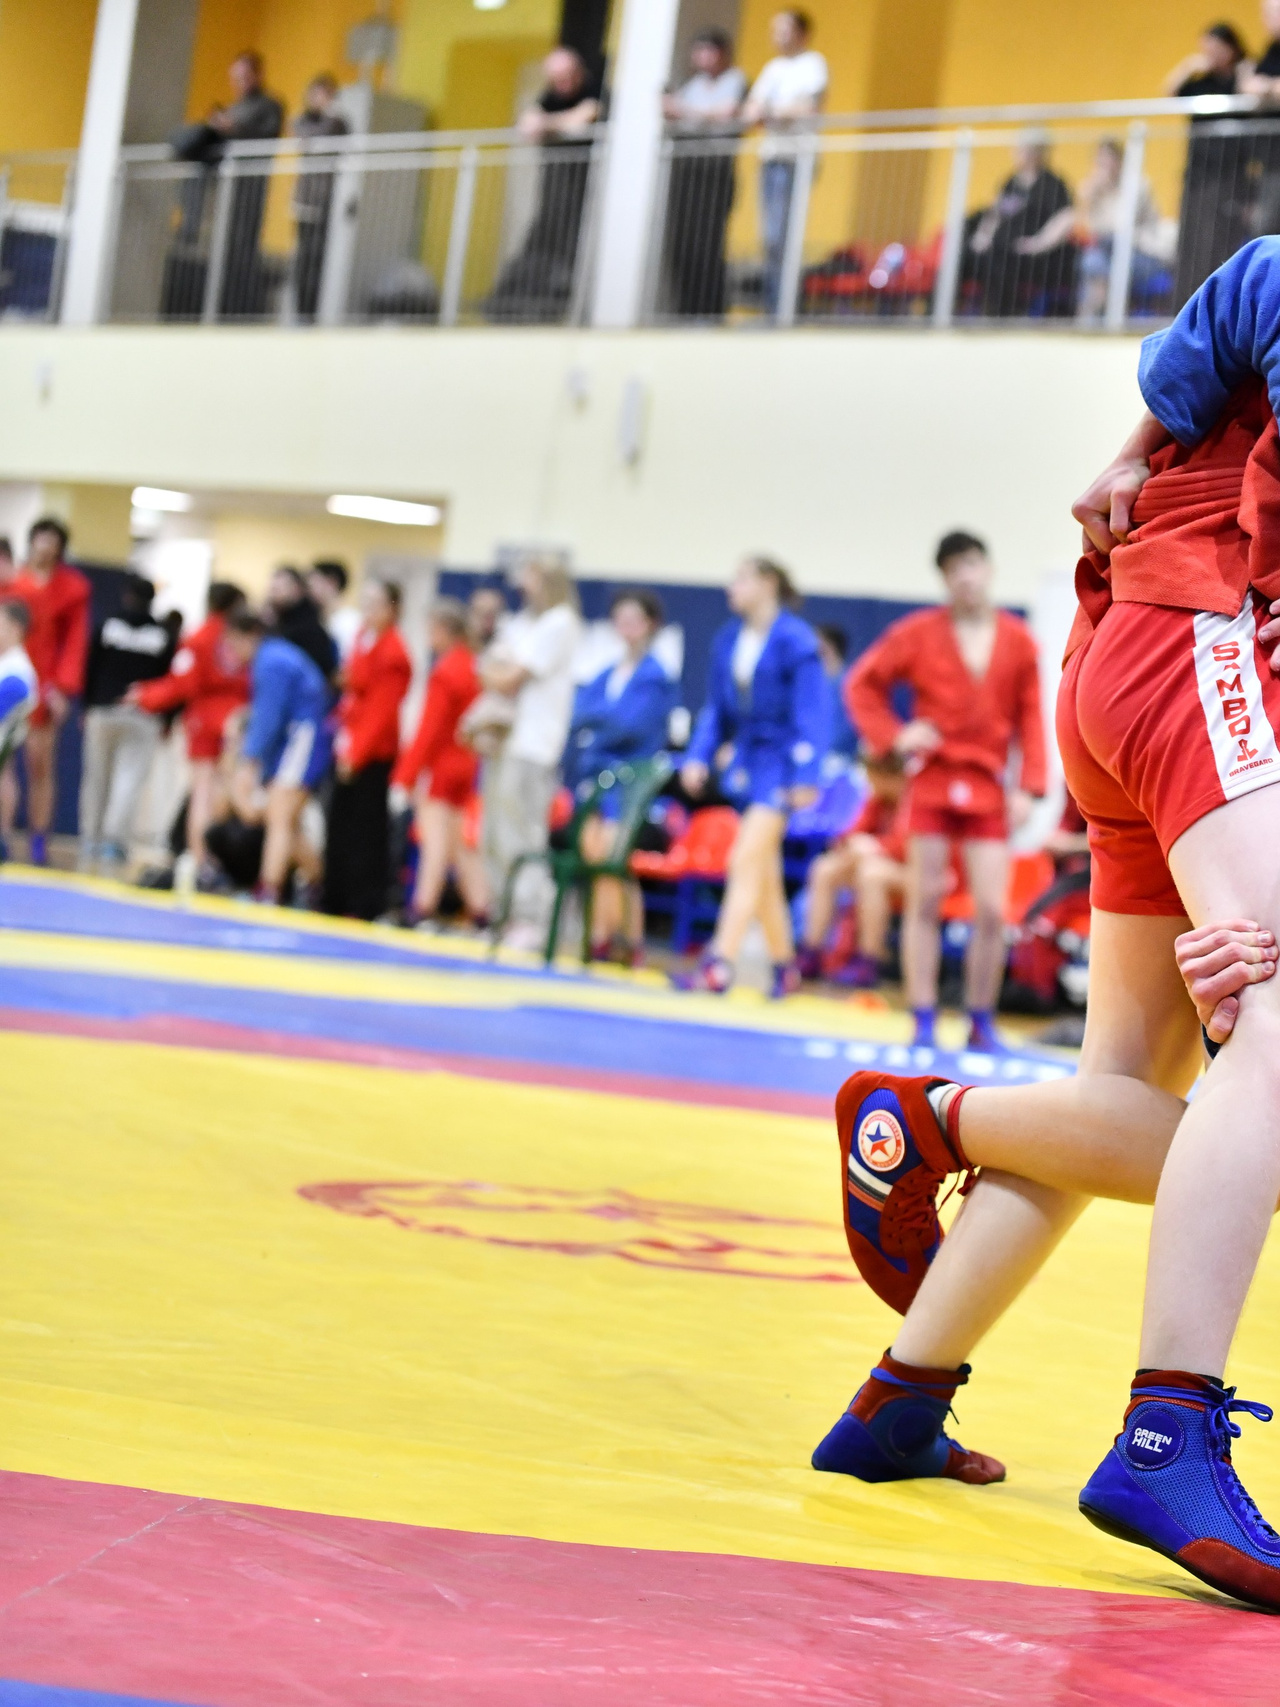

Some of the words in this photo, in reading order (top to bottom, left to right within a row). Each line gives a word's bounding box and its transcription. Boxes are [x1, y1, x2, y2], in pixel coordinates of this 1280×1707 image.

[1228, 757, 1274, 777] BRAVEGARD
[1132, 1434, 1163, 1453] HILL
[1134, 1427, 1172, 1445] GREEN
